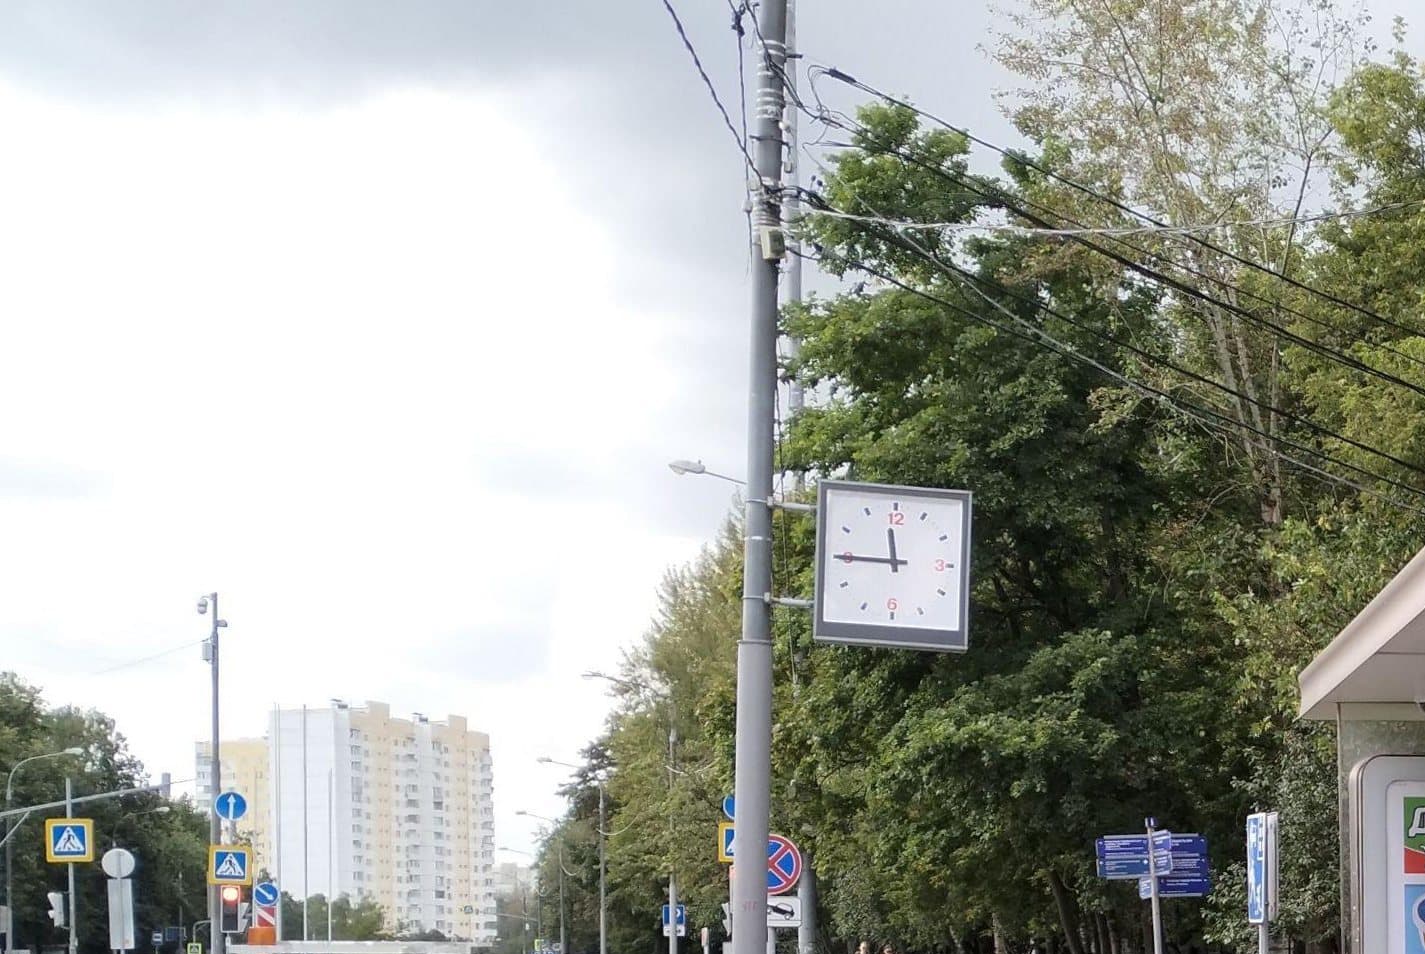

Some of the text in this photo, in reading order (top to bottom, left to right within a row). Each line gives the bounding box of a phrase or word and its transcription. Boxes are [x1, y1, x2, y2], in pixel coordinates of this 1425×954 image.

[888, 514, 904, 526] 12
[935, 559, 945, 572] 3
[887, 598, 898, 611] 6
